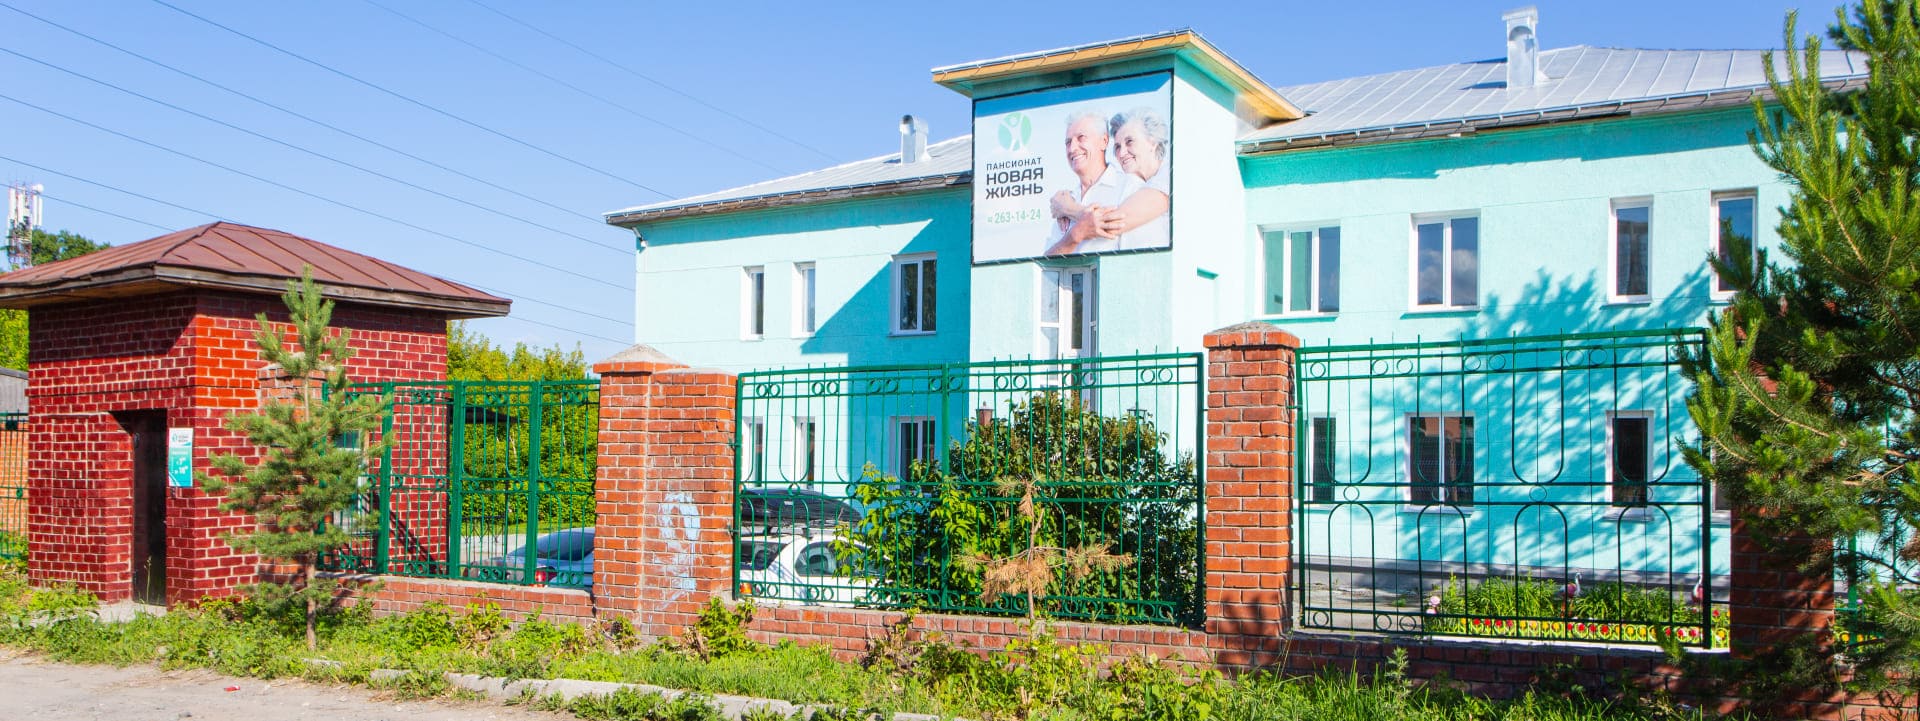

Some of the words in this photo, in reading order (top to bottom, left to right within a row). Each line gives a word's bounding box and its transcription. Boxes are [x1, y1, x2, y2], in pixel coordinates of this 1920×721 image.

[986, 157, 1042, 171] ПАНСИОНАТ
[986, 167, 1044, 186] НОВАЯ
[985, 183, 1044, 200] ЖИЗНЬ
[994, 208, 1041, 224] 263-14-24
